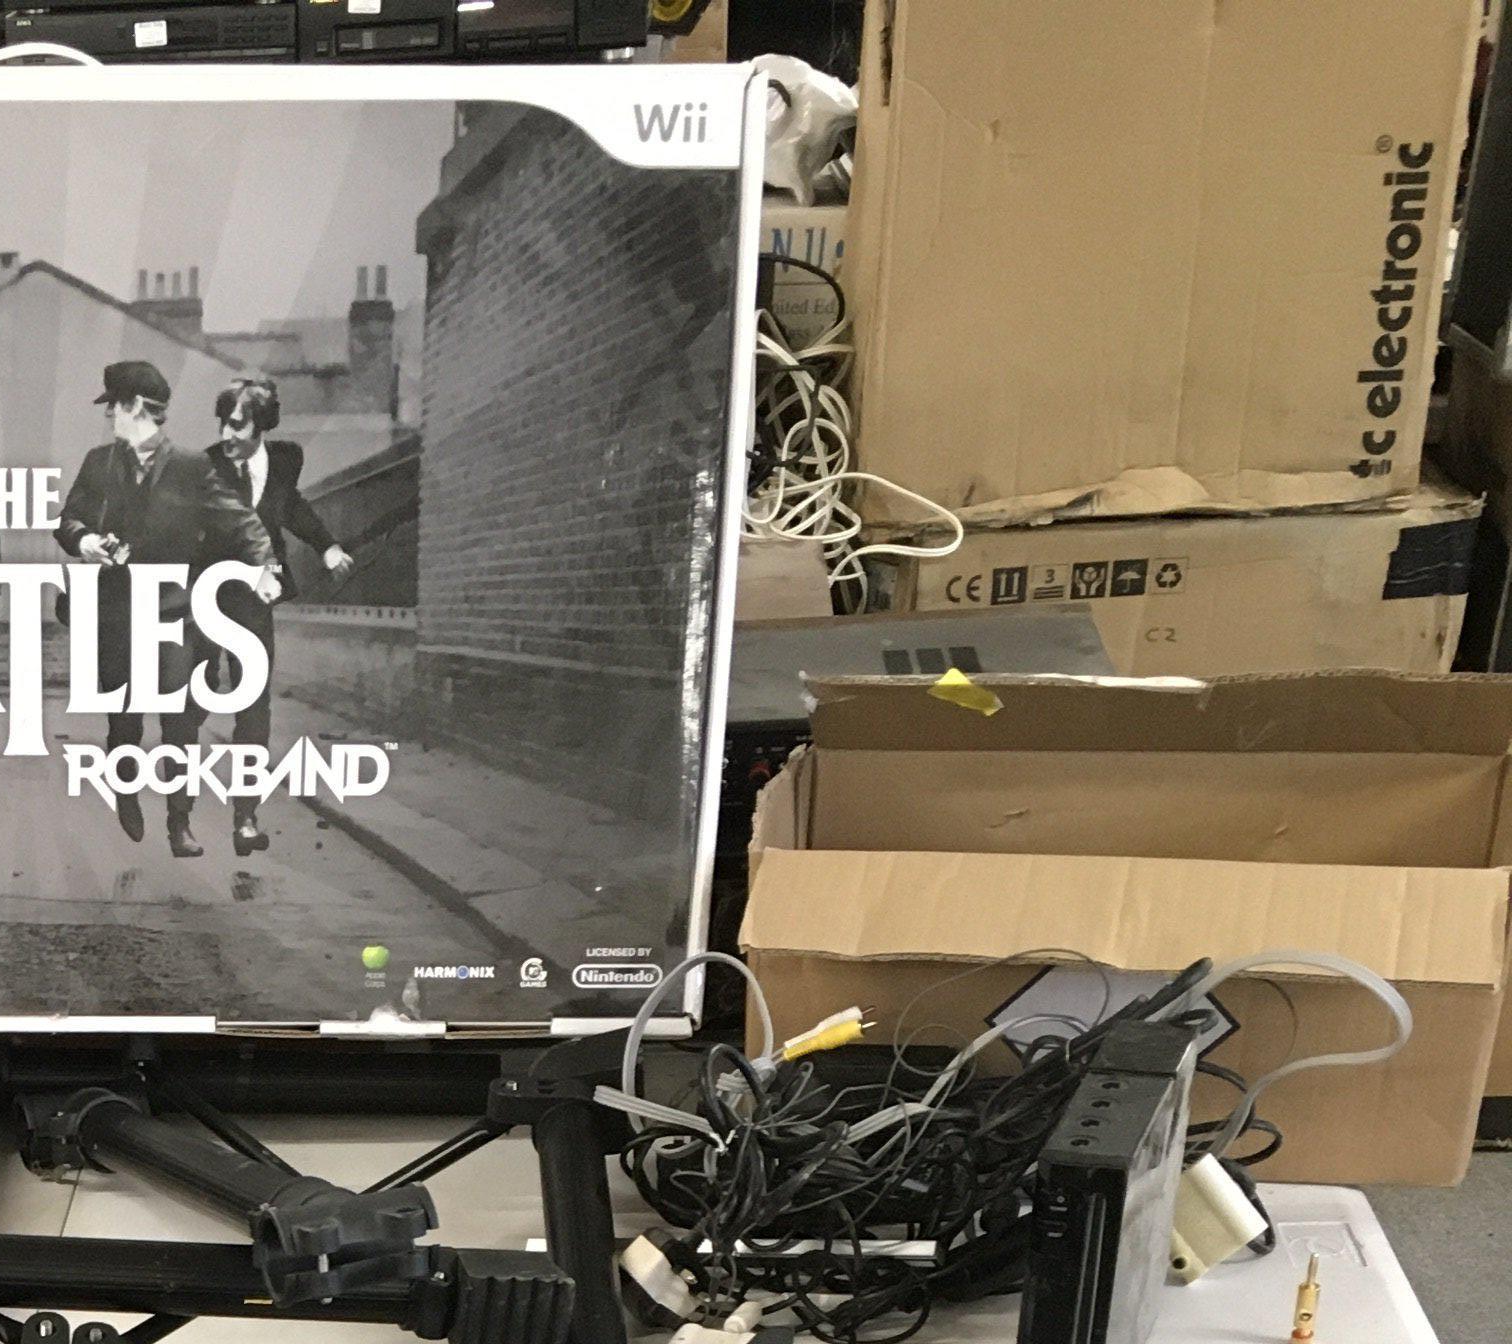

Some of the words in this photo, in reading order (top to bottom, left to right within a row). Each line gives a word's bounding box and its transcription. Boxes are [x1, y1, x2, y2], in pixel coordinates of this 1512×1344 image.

[633, 102, 708, 143] Wii
[1357, 141, 1434, 420] electronic
[1349, 429, 1397, 478] tc
[1044, 568, 1056, 585] 3
[586, 947, 636, 957] LICENSED
[637, 947, 652, 957] BY
[413, 965, 495, 979] HARMONIX
[580, 970, 655, 983] Nintendo
